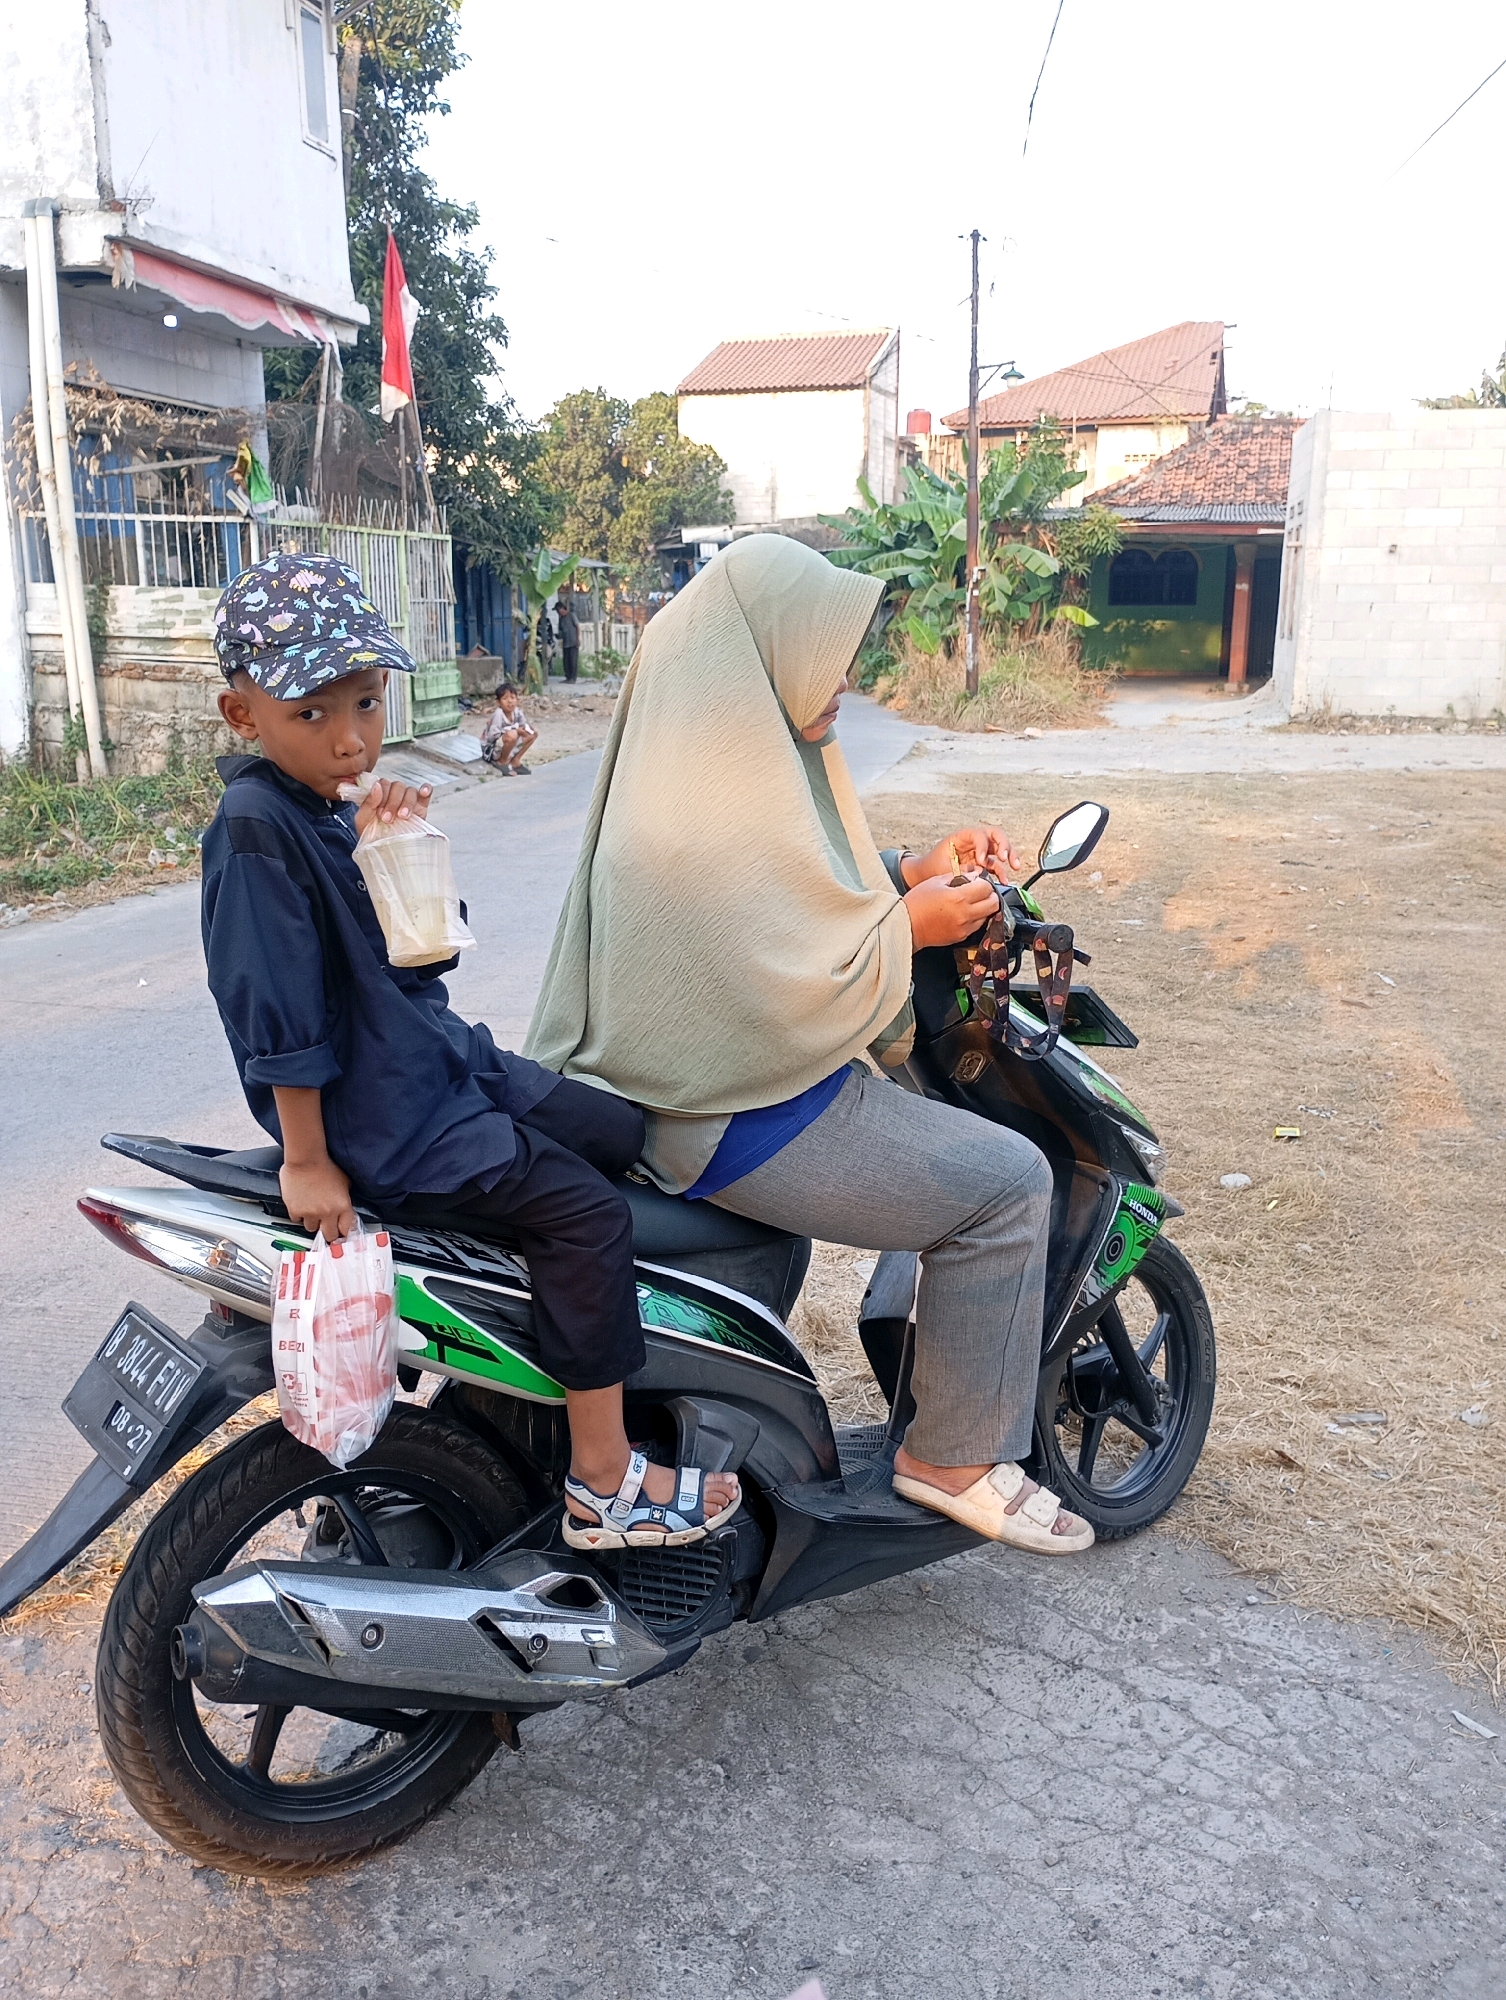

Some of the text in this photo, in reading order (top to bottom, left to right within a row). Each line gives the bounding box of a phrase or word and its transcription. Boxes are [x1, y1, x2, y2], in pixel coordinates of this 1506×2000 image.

[1128, 1199, 1158, 1226] HONDA
[105, 1323, 129, 1358] B
[117, 1334, 163, 1388] 3844
